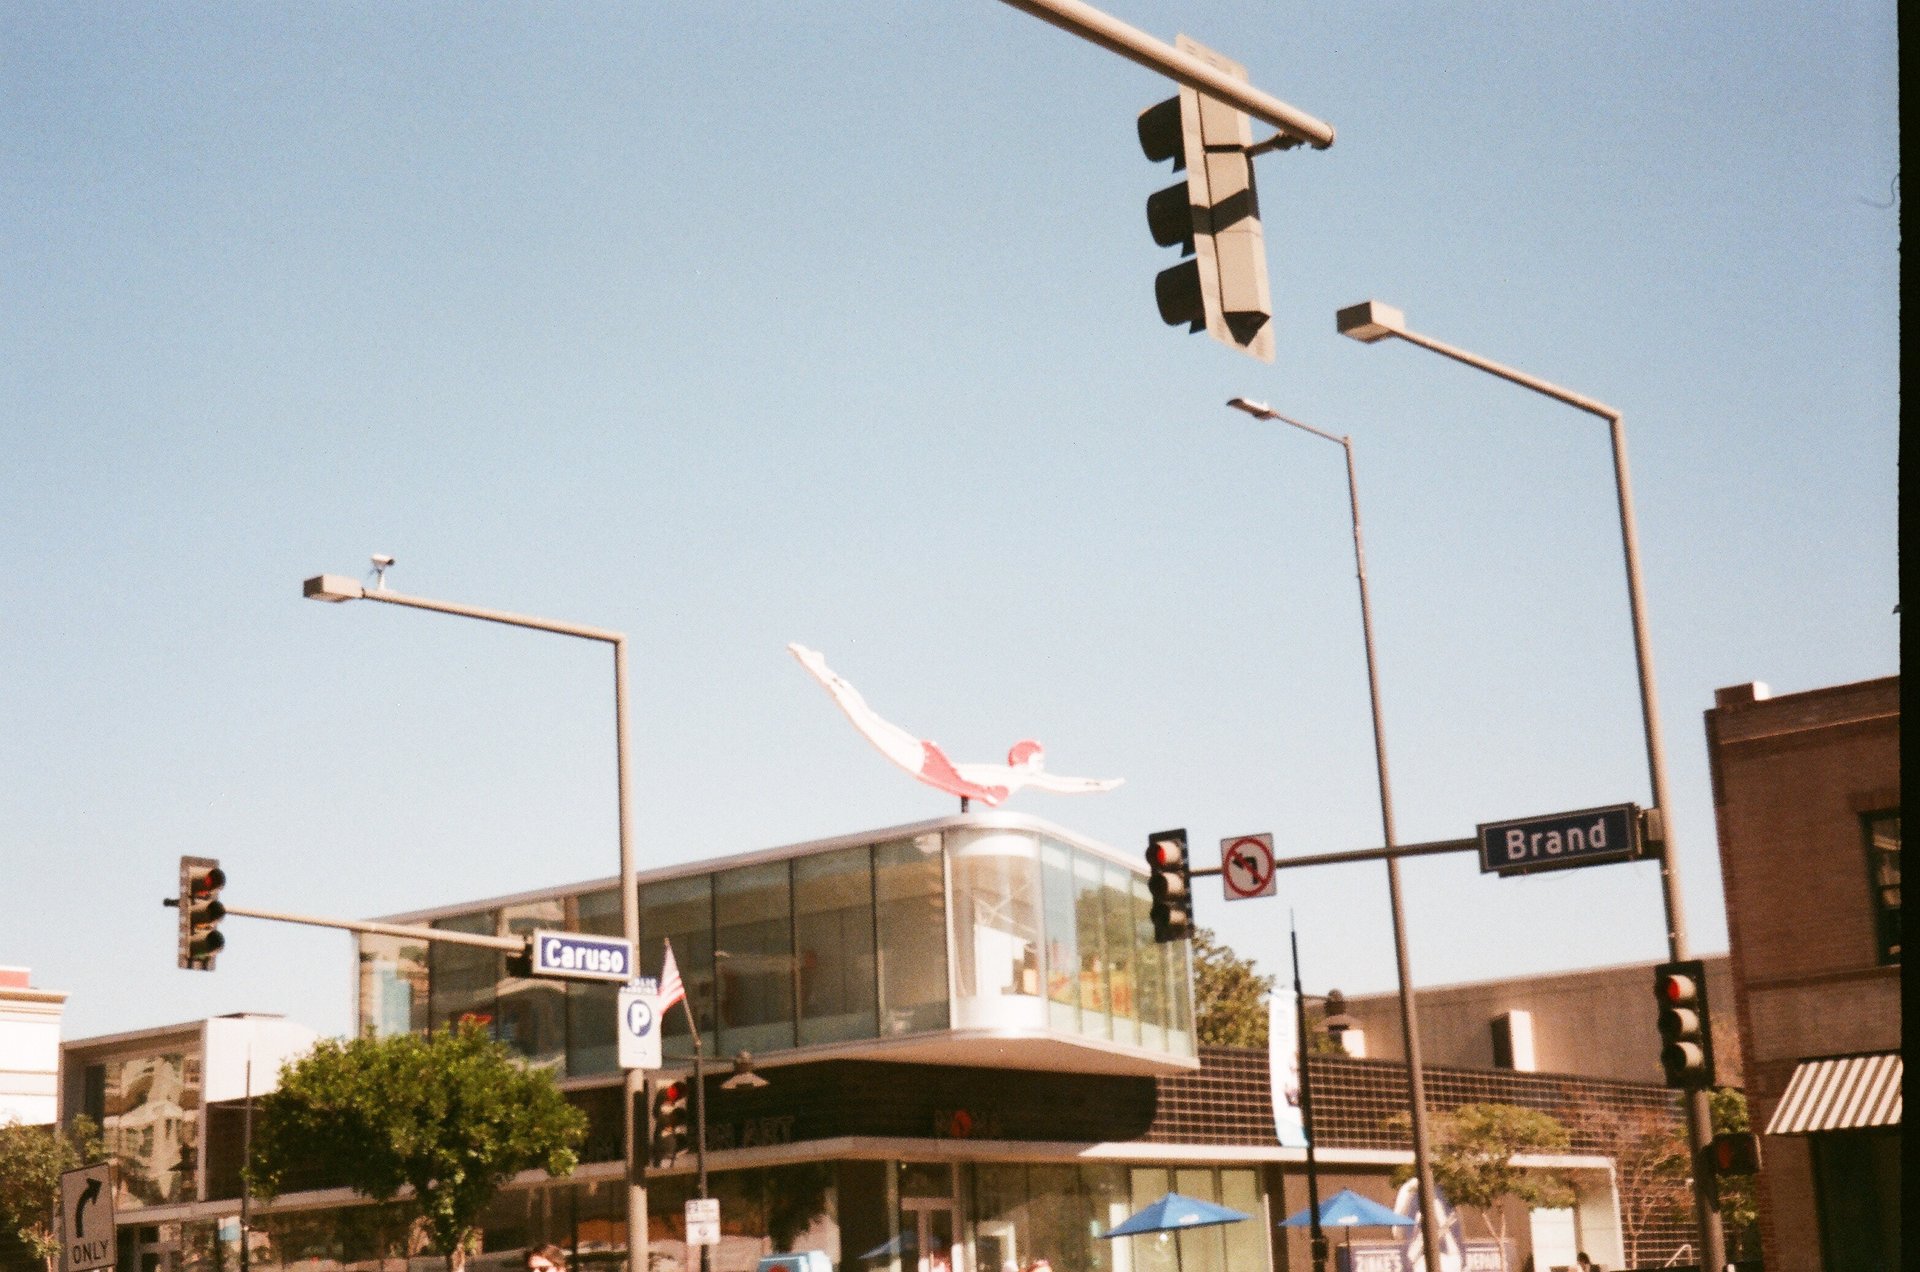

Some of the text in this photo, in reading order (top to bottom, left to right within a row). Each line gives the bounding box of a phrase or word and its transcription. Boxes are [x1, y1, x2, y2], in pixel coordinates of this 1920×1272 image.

[1506, 818, 1607, 860] Brand
[546, 939, 624, 973] Caruso
[632, 1002, 651, 1033] P
[73, 1240, 110, 1264] ONLY
